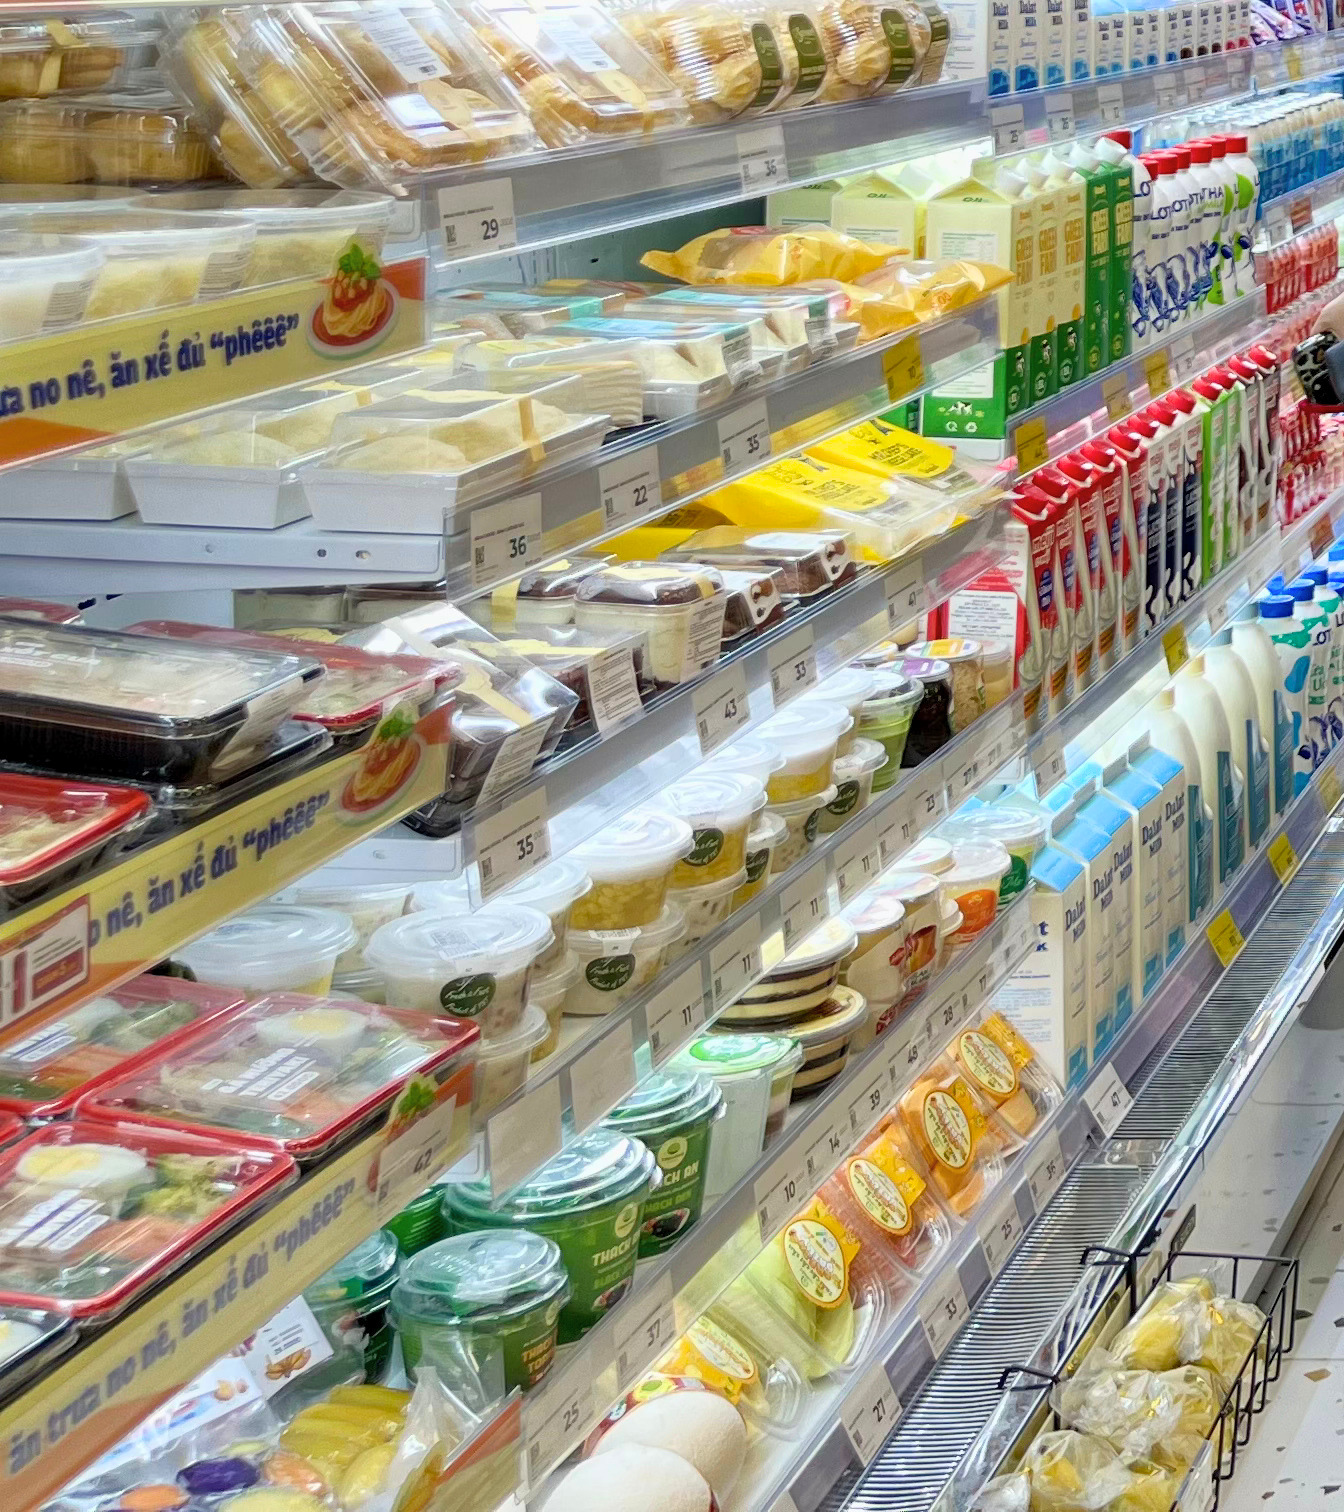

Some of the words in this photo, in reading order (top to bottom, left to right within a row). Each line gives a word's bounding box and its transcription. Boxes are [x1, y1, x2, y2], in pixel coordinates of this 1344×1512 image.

[765, 160, 777, 177] 36
[481, 219, 498, 240] 29
[31, 376, 61, 409] no
[67, 359, 105, 398] nê,
[110, 351, 139, 388] ăn
[145, 329, 171, 381] xế
[177, 331, 205, 372] đủ
[747, 434, 759, 453] 35
[633, 485, 647, 506] 22
[510, 536, 526, 558] 36
[725, 699, 736, 718] 43
[517, 834, 533, 860] 35
[862, 855, 869, 871] 11
[106, 890, 141, 939] nê,
[148, 869, 174, 913] ăn
[179, 841, 206, 897] xế
[210, 835, 238, 878] đủ
[810, 898, 818, 916] 11
[742, 954, 750, 973] 11
[682, 1006, 691, 1025] 11
[870, 1090, 880, 1110] 39
[829, 1134, 839, 1153] 14
[413, 1148, 432, 1173] 42
[784, 1181, 795, 1202] 10
[647, 1319, 660, 1344] 37
[9, 1422, 41, 1474] ăn
[46, 1394, 101, 1445] trưa
[106, 1355, 136, 1399] no
[141, 1328, 177, 1381] nê,
[182, 1294, 208, 1338] ăn
[212, 1254, 238, 1326] xế
[243, 1239, 269, 1290] đủ
[563, 1404, 582, 1432] 25
[873, 1398, 885, 1422] 27
